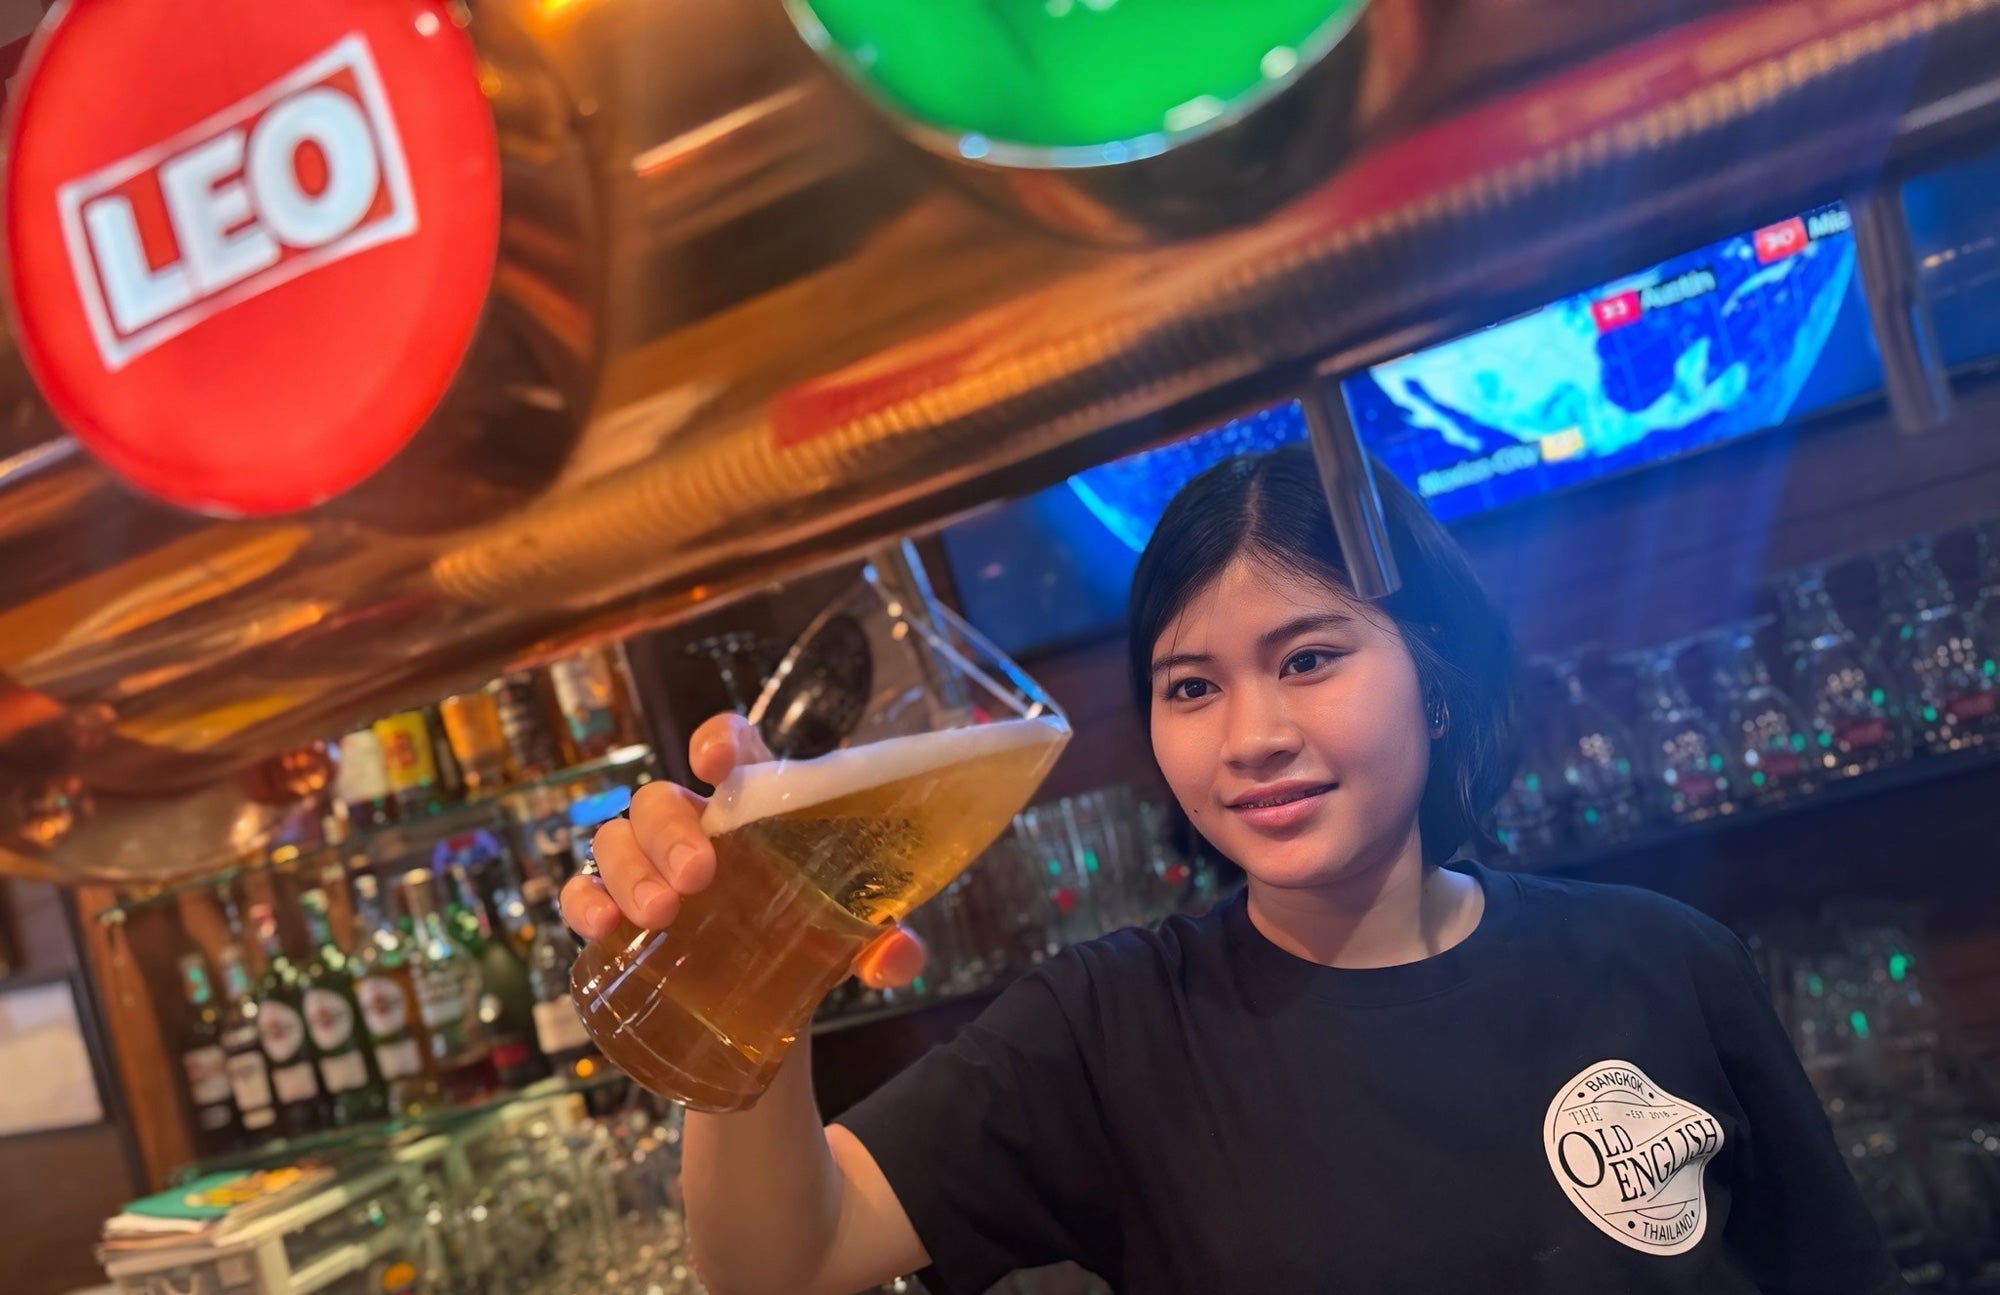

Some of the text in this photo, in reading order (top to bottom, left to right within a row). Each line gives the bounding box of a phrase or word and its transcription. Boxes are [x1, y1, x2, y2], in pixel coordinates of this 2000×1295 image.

[86, 85, 380, 334] LEO
[1585, 1071, 1644, 1095] BANGKOK
[1569, 1106, 1603, 1126] THE
[1558, 1124, 1634, 1189] OLD
[1608, 1118, 1718, 1203] ENGLISH
[1643, 1214, 1693, 1241] THAILAND
